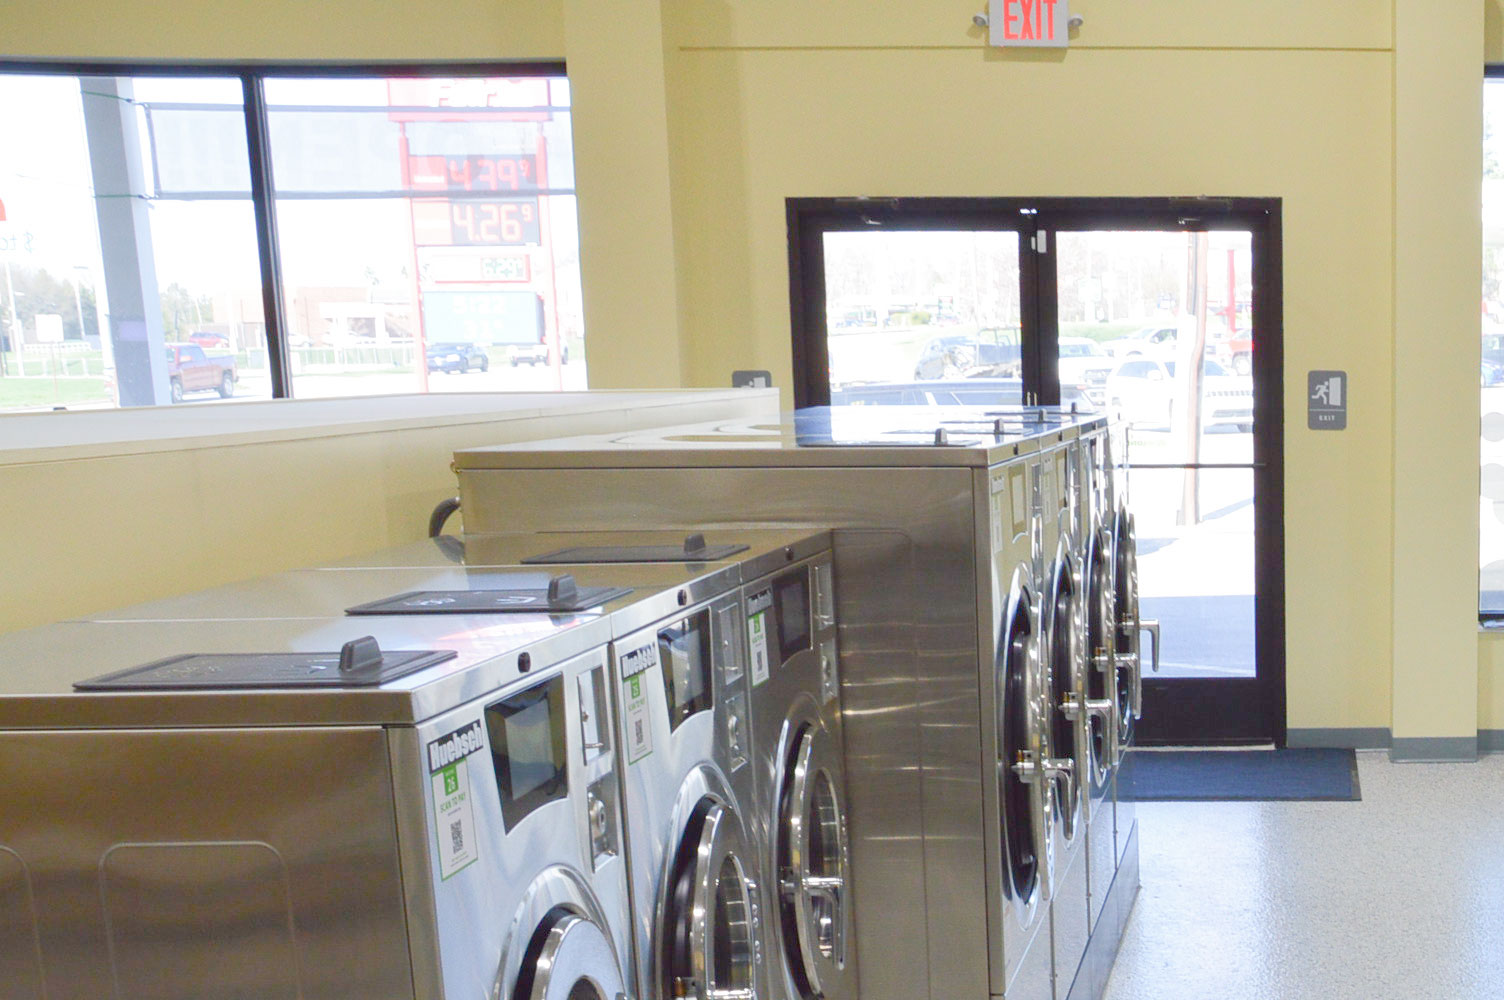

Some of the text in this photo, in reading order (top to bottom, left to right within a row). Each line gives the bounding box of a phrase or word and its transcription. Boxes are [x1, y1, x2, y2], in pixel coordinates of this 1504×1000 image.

[1003, 0, 1057, 40] EXIT
[622, 642, 656, 678] Huebsch
[429, 723, 483, 770] Huebsch
[447, 775, 457, 793] 26
